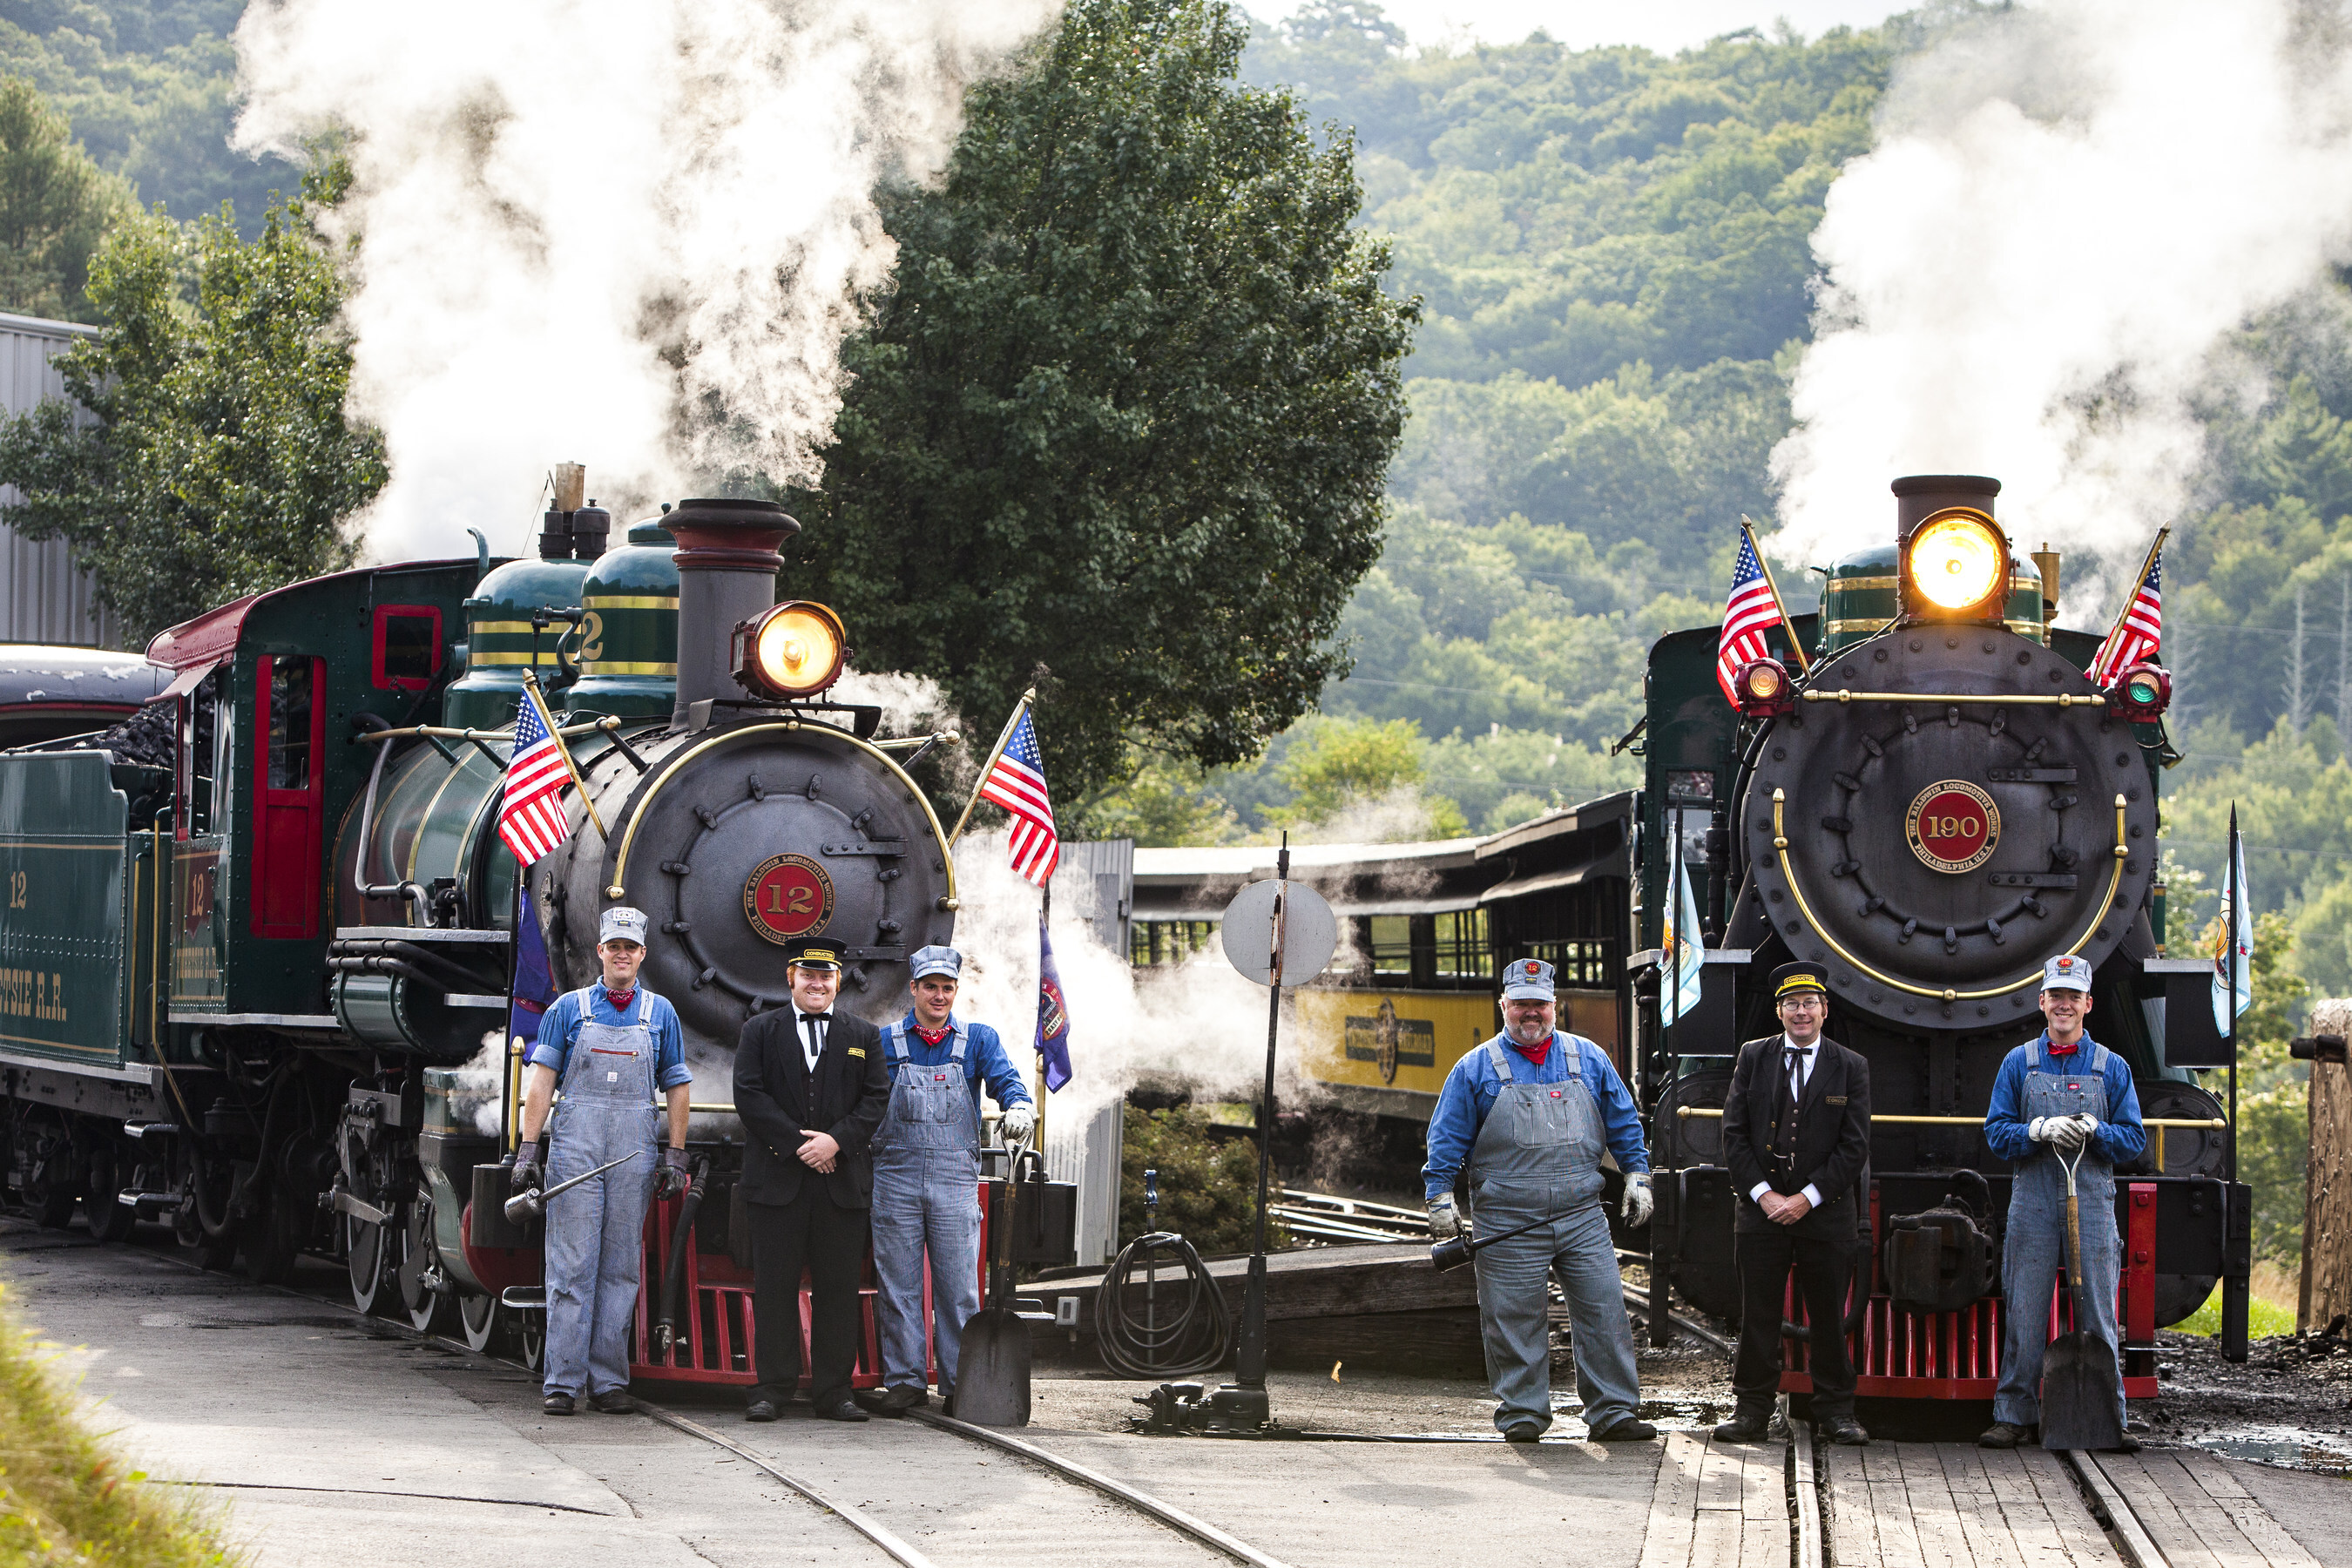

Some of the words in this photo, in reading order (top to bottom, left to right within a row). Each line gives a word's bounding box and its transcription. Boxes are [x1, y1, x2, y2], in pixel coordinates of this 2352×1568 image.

[1911, 786, 1941, 817] BALDWIN
[1943, 783, 1991, 808] LOCOMOTIVE
[1987, 808, 1997, 838] WORKS
[1928, 816, 1980, 838] 190
[10, 871, 27, 909] 12
[192, 873, 205, 916] 12
[749, 857, 780, 887] BALDWIN
[782, 855, 828, 882] LOCOMOTIVE
[823, 882, 833, 911] WORKS
[767, 884, 814, 914] 12
[36, 970, 67, 1023] R.R.
